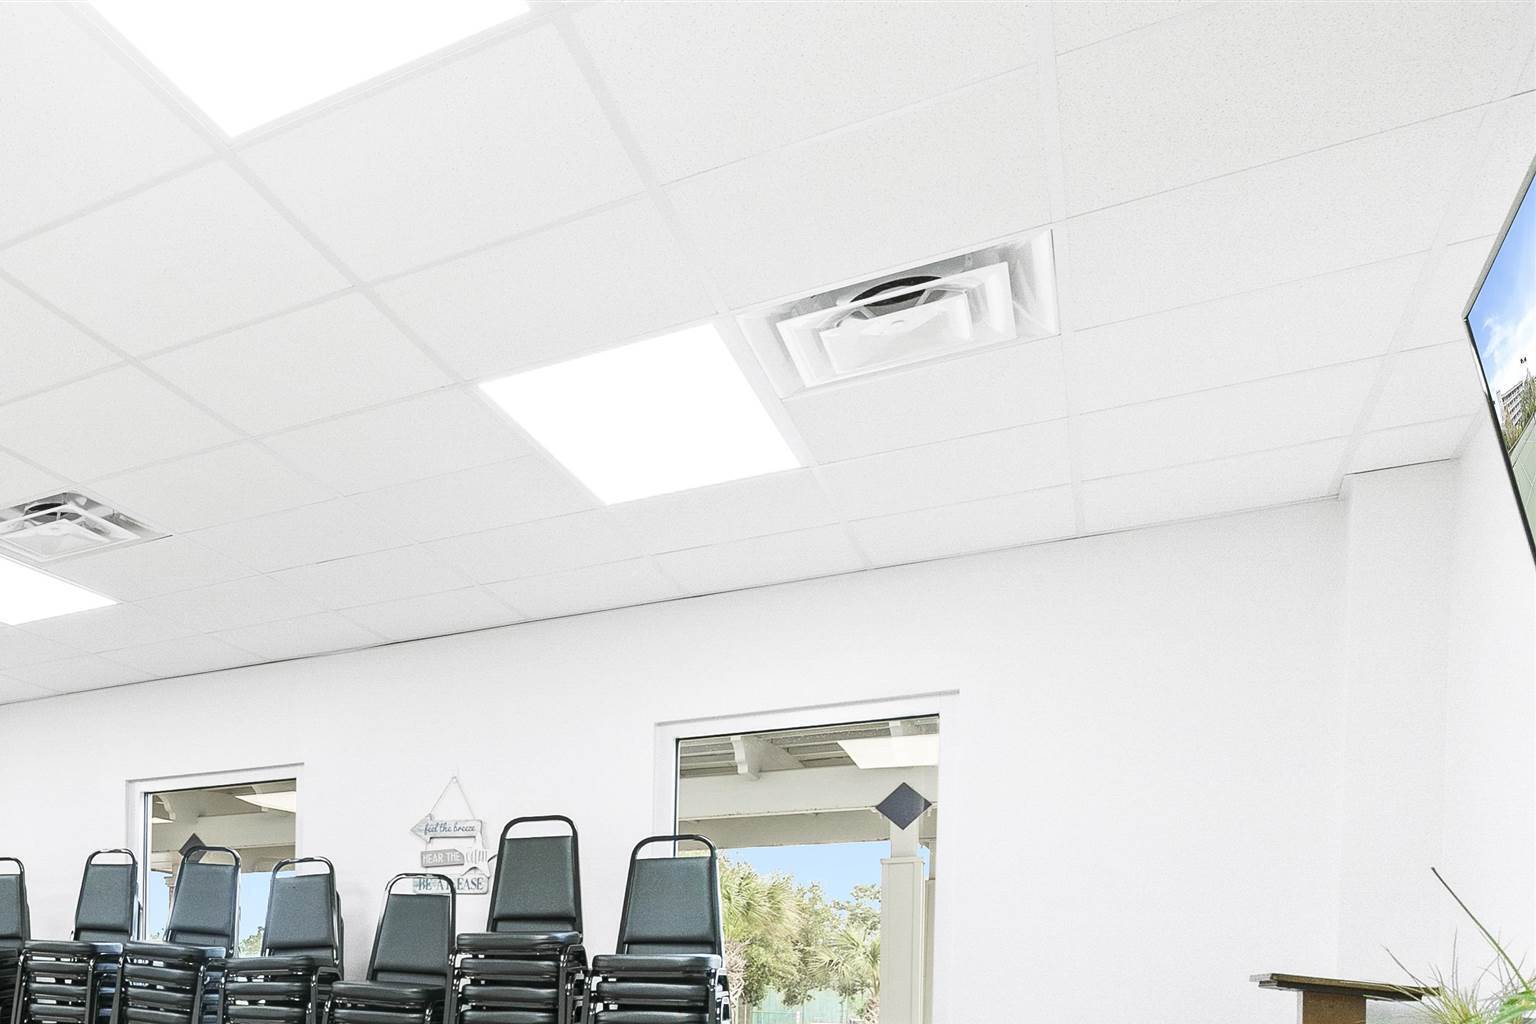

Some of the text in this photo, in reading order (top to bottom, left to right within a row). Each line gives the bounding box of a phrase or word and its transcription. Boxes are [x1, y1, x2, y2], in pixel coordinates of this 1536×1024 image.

[424, 822, 475, 835] feel the breeze
[423, 851, 462, 865] HEAR THE
[418, 878, 433, 891] BE
[457, 877, 485, 891] EASE
